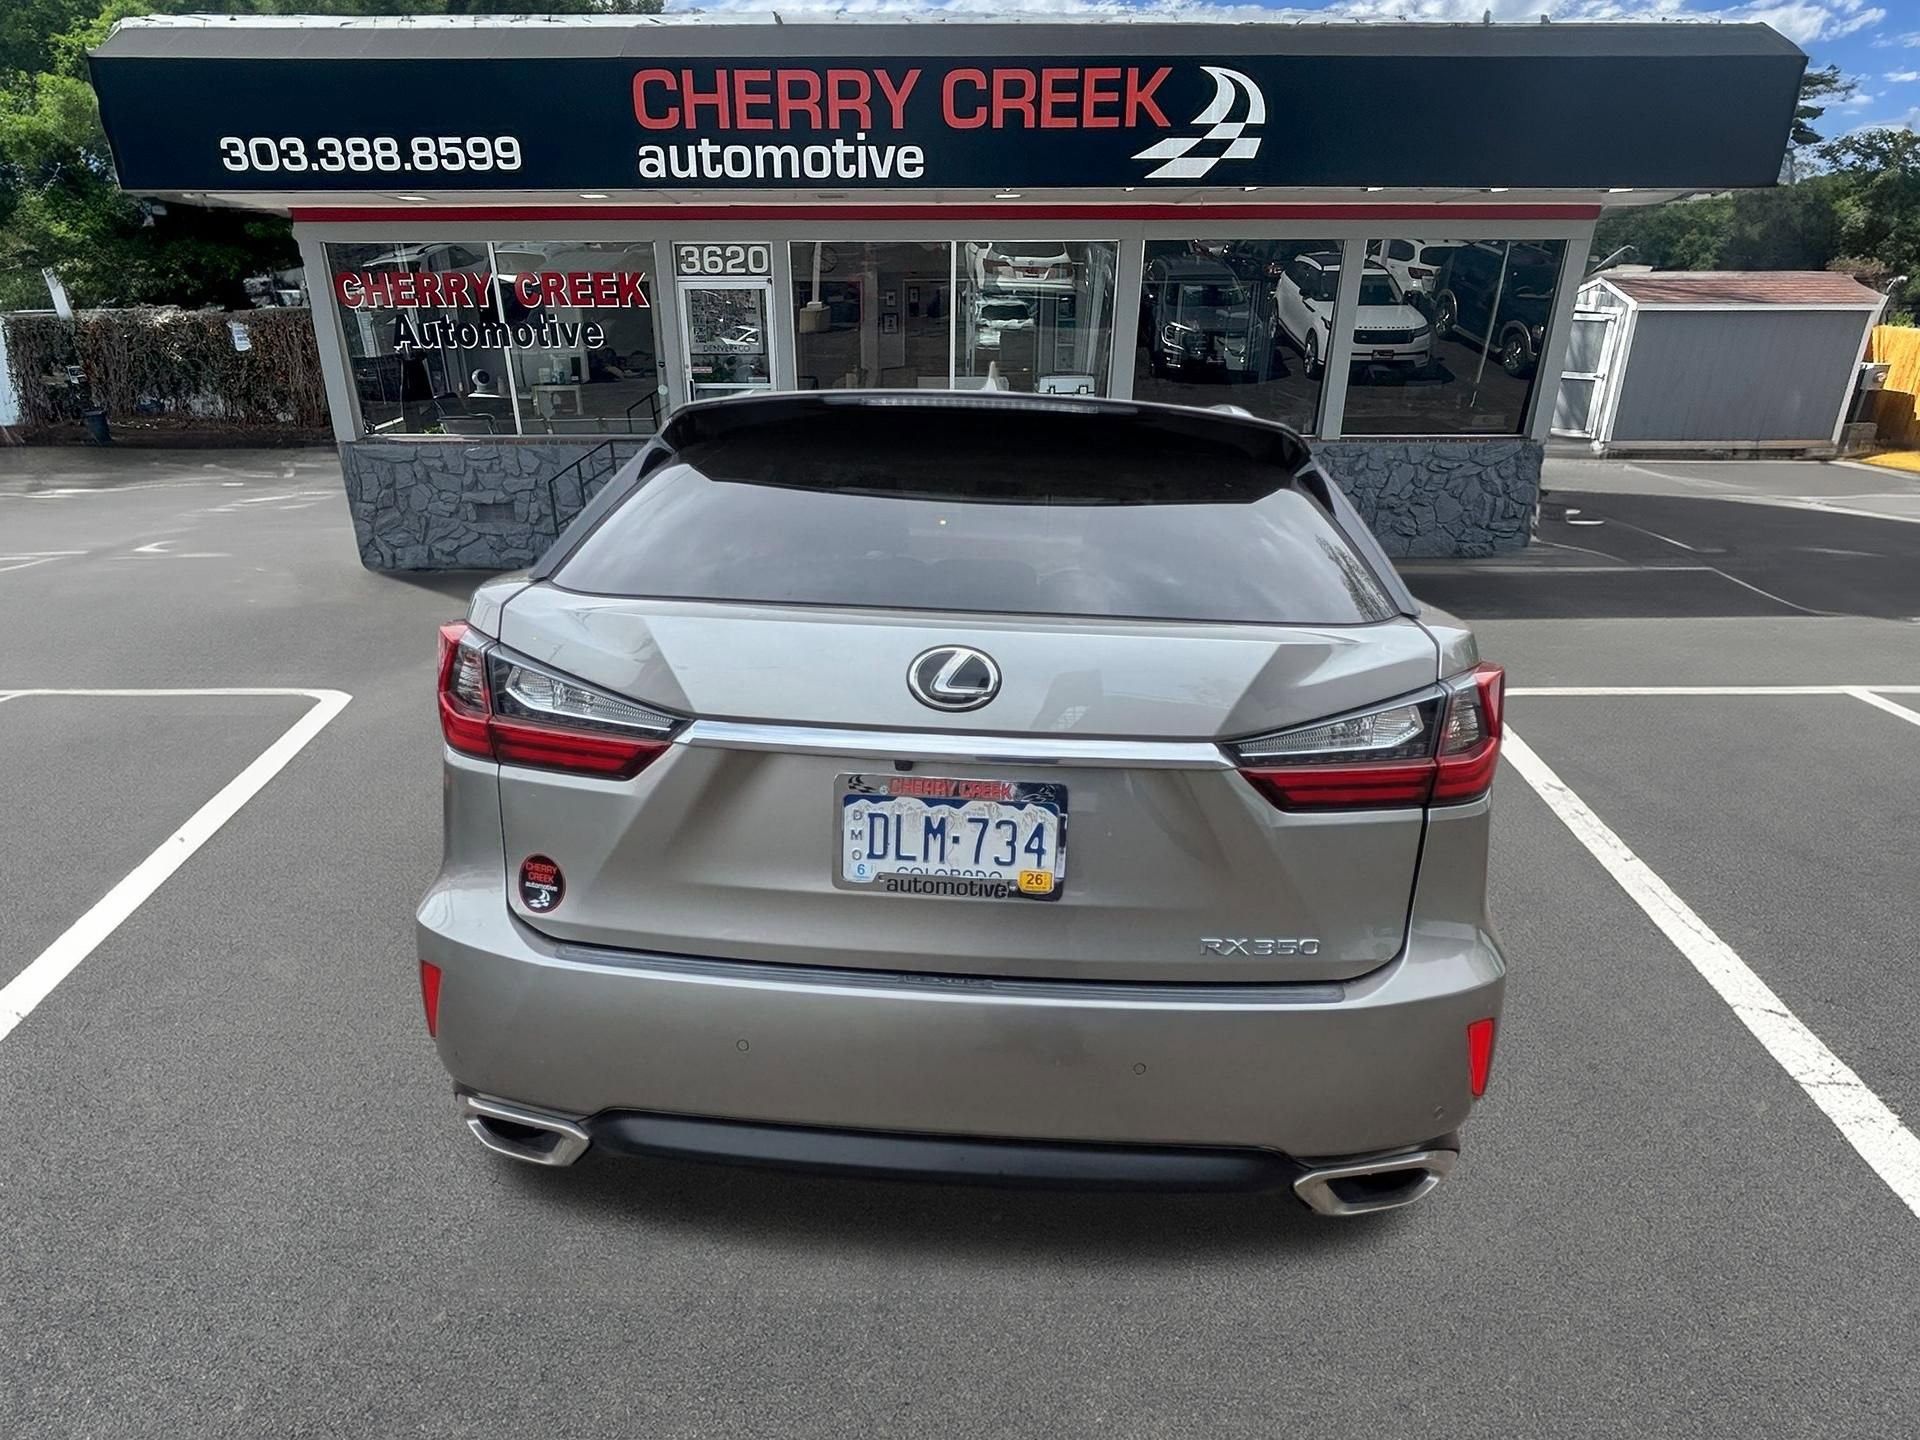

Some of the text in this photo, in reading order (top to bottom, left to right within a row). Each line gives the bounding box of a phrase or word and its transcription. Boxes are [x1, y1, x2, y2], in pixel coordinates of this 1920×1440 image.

[632, 67, 1173, 130] CHERRY CREEK
[219, 136, 522, 171] 303.388.8599
[638, 132, 924, 179] automotive
[680, 245, 769, 273] 3620
[335, 271, 651, 309] CHERRY CREEK
[393, 314, 605, 350] Automotive
[961, 781, 1014, 800] CREEK
[886, 877, 1008, 898] automotive
[1026, 873, 1044, 886] 26
